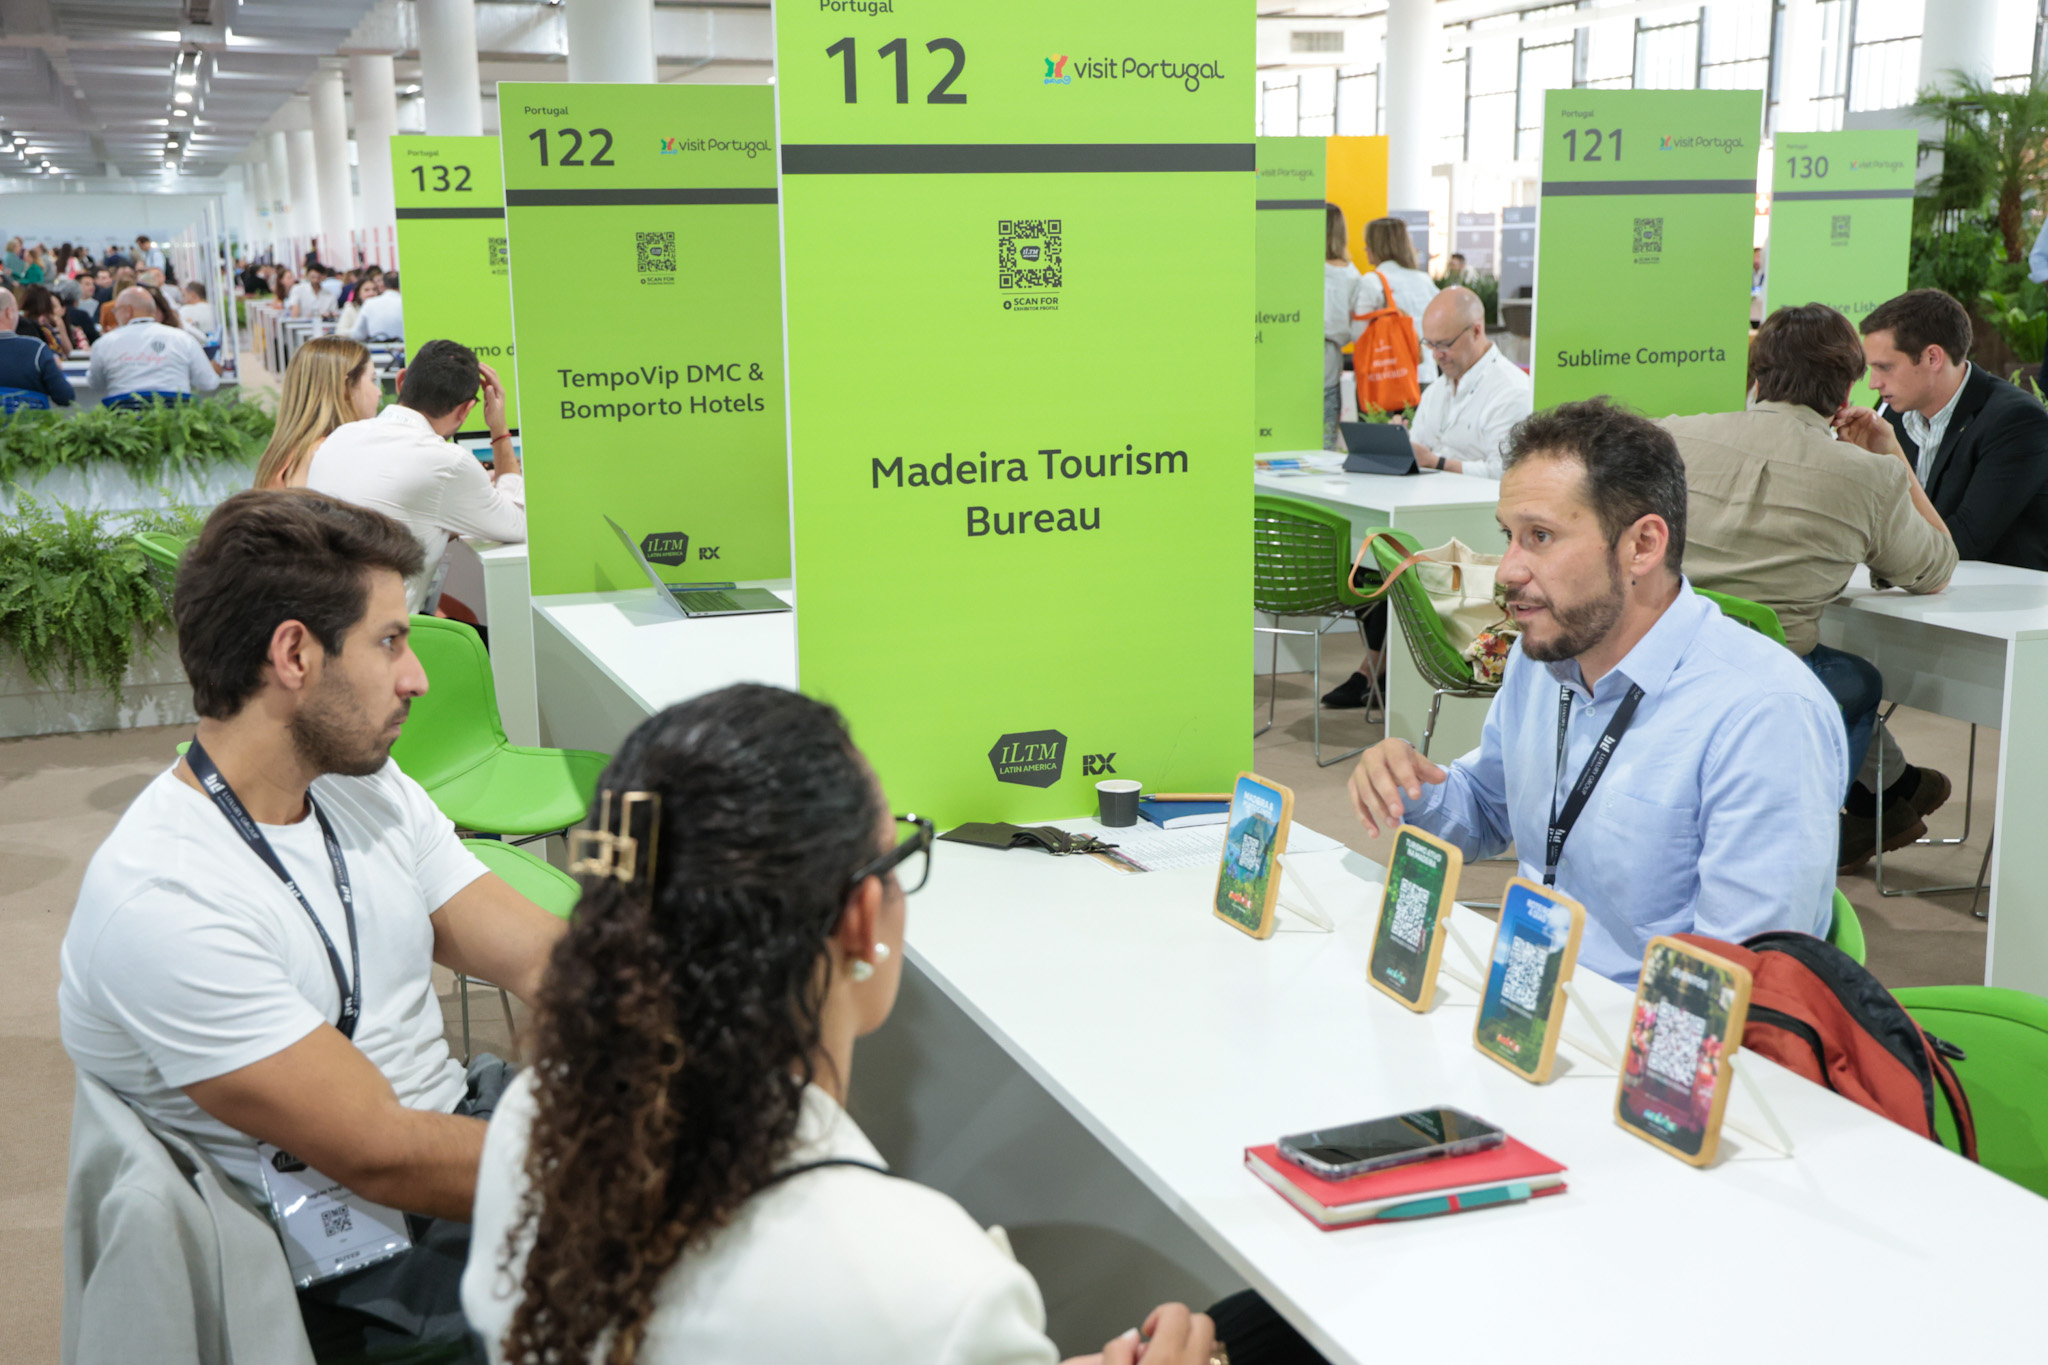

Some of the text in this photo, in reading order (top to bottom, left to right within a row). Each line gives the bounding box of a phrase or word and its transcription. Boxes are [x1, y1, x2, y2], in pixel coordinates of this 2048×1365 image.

[820, 0, 894, 17] Portugal
[825, 37, 967, 104] 112
[1074, 57, 1225, 93] visit Portugal
[524, 106, 569, 117] Portugal
[1561, 110, 1595, 119] Portugal
[407, 149, 440, 158] Portugal
[529, 128, 615, 167] 122
[679, 138, 772, 159] visit Portugal
[1562, 129, 1623, 162] 121
[1674, 137, 1744, 154] visit Portugal
[411, 165, 473, 192] 132
[1787, 156, 1829, 179] 130
[1041, 297, 1059, 305] FOR
[1558, 347, 1726, 367] Sublime Comporta
[558, 363, 764, 391] TempoVip DMC &
[561, 393, 765, 422] Bomporto Hotels
[872, 444, 1188, 489] Madeira Tourism
[967, 506, 1101, 537] Bureau
[648, 539, 684, 552] ILTM
[699, 546, 720, 560] RX
[1000, 742, 1059, 765] ILTM
[1083, 752, 1117, 776] RX
[1000, 762, 1057, 775] LATIN AMERICA
[1582, 753, 1607, 796] LUXURY GROUP
[222, 791, 242, 817] LUXURY
[241, 817, 260, 839] GROUP
